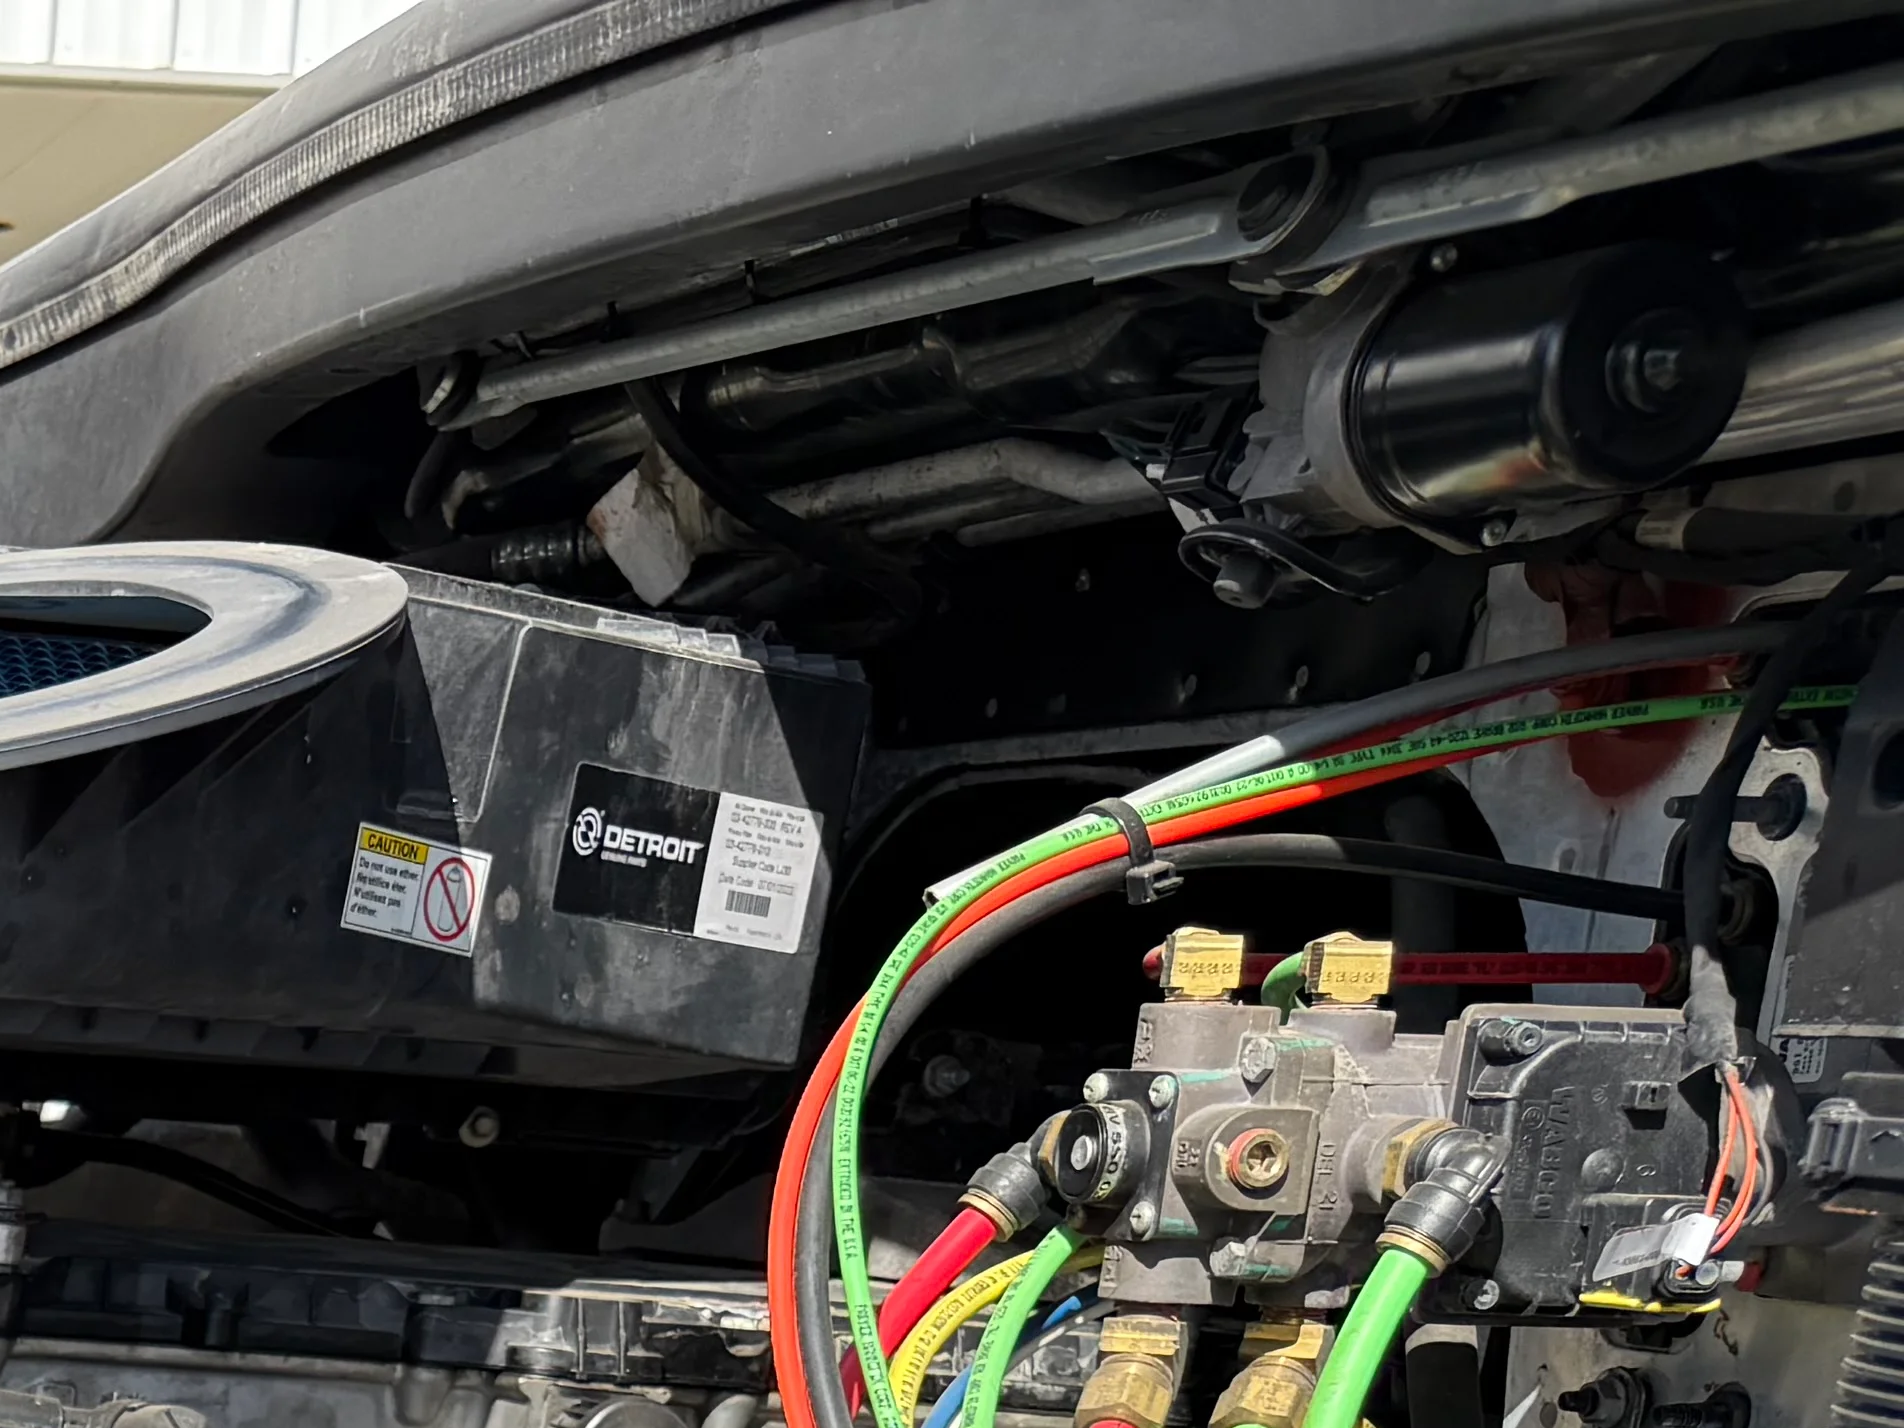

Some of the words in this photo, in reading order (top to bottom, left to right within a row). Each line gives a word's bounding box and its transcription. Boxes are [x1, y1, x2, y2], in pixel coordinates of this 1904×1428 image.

[368, 833, 419, 860] CAUTION
[603, 824, 705, 864] DETROIT
[359, 856, 370, 869] Do
[371, 862, 384, 871] not
[385, 865, 398, 875] use
[1533, 1086, 1576, 1218] WABCO
